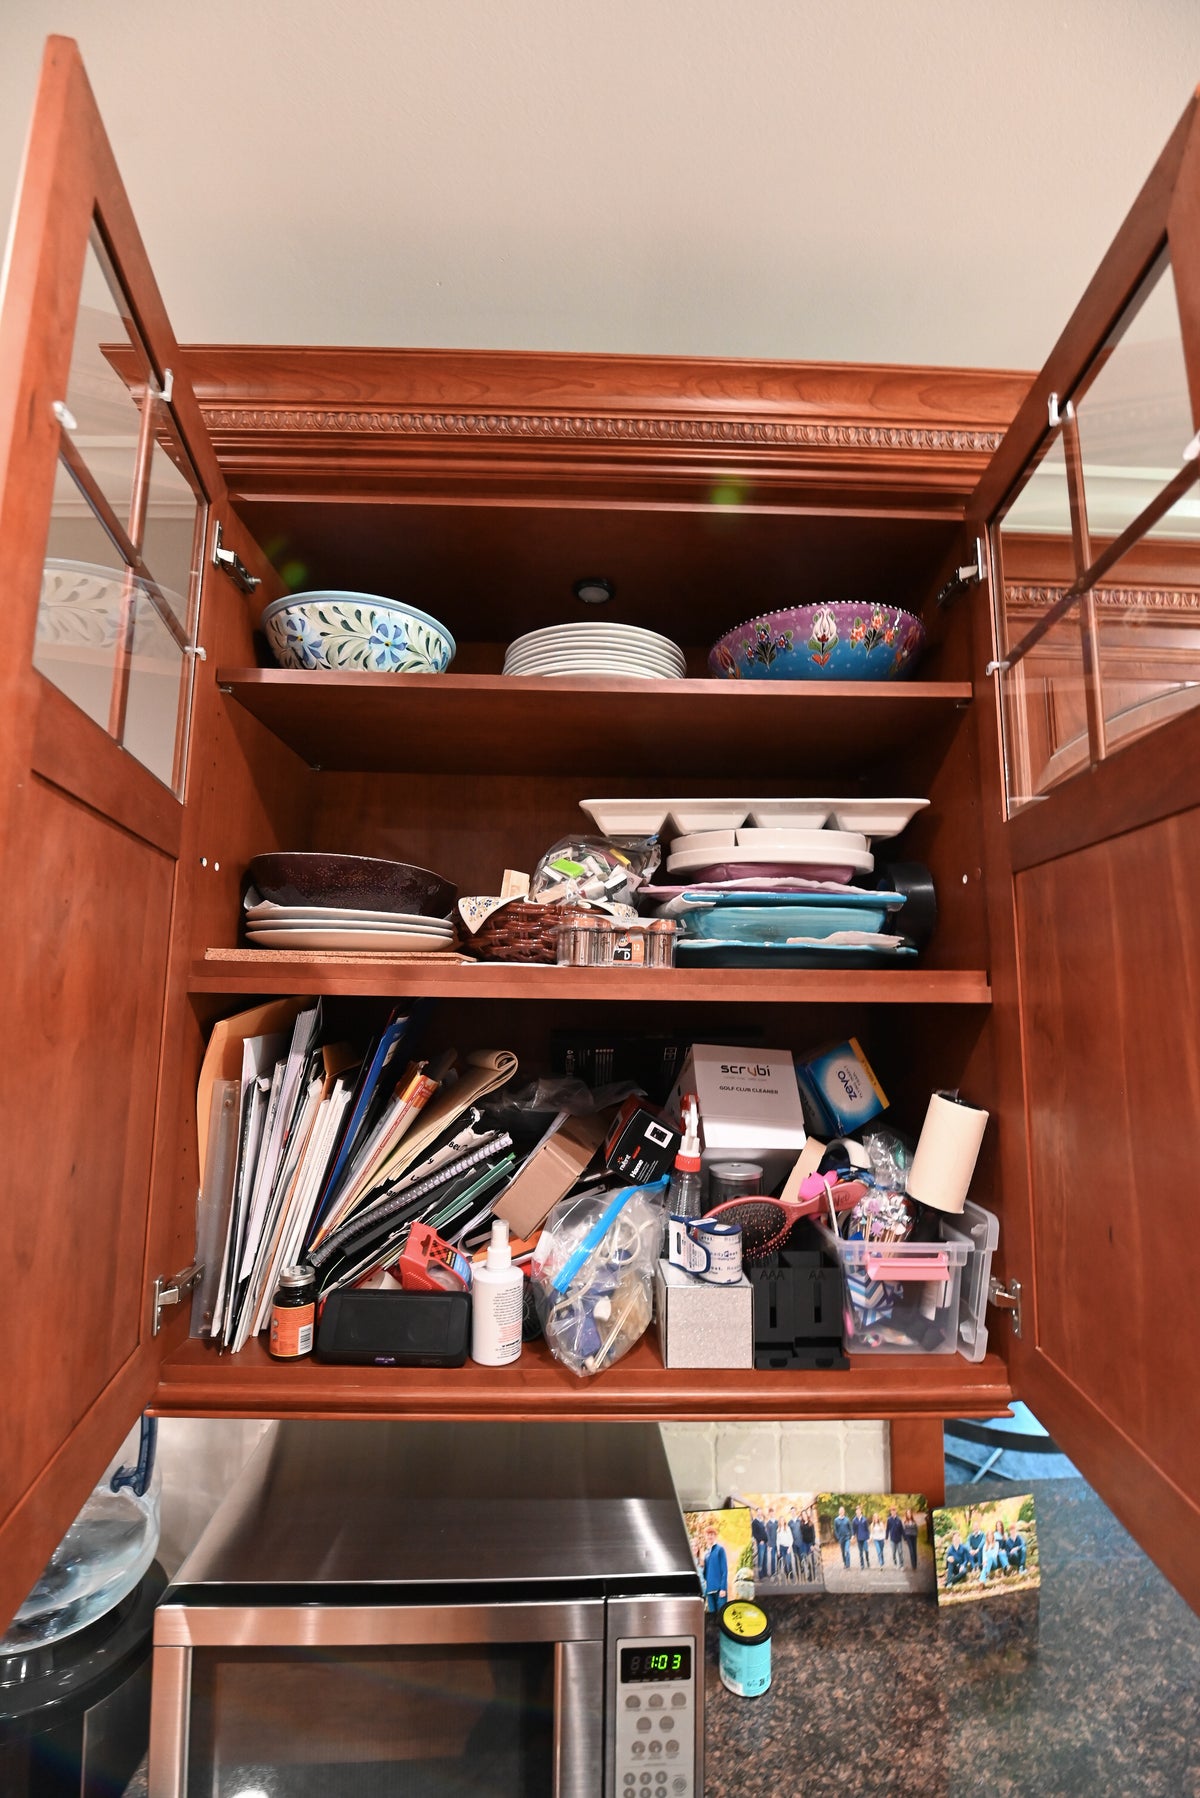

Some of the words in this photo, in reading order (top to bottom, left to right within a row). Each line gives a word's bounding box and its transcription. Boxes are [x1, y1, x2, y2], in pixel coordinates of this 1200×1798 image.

[623, 951, 631, 960] D
[720, 1064, 771, 1077] scrubi
[751, 1087, 779, 1095] CLEANER
[837, 1070, 858, 1101] zevo
[629, 1159, 644, 1178] Home
[759, 1269, 785, 1280] AAA
[807, 1269, 826, 1280] AA
